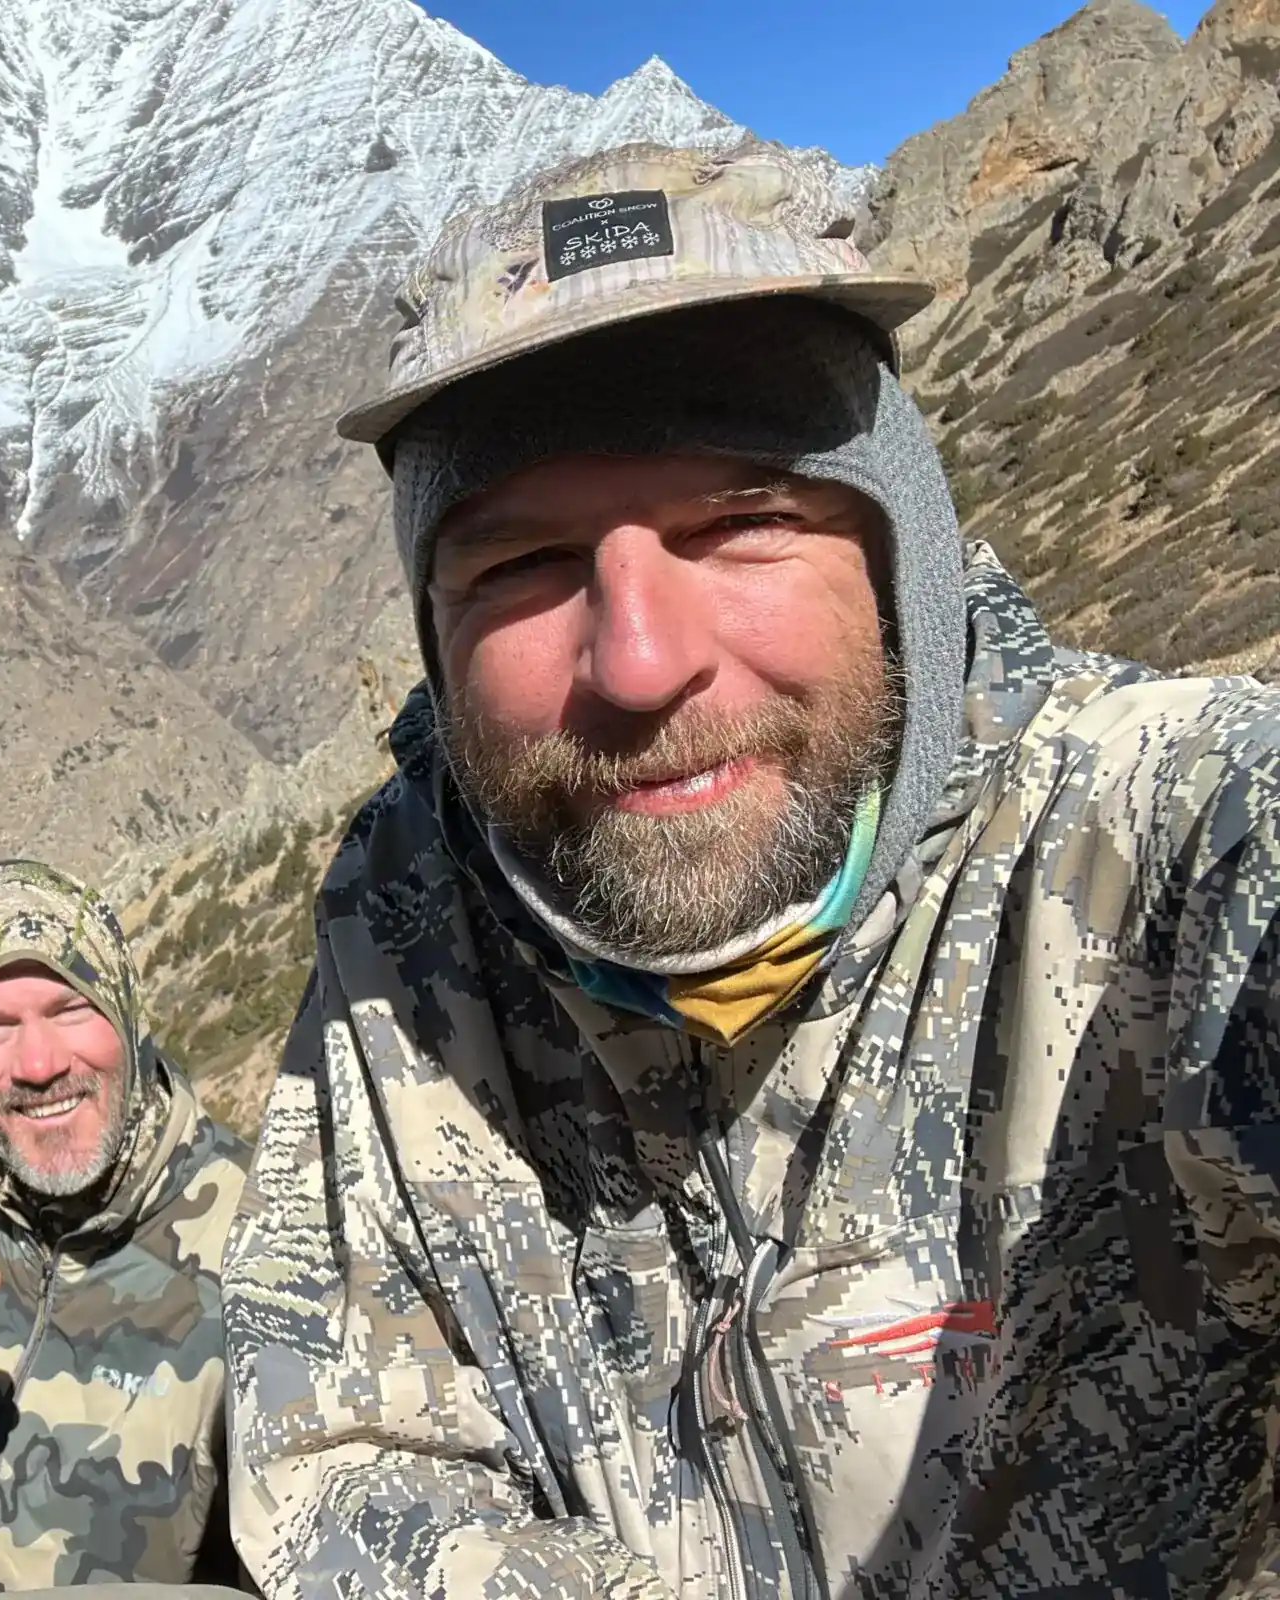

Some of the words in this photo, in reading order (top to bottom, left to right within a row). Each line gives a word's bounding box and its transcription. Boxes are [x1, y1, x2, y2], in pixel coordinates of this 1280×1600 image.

[552, 208, 615, 230] COALITION
[618, 203, 657, 213] SNOW
[563, 222, 650, 250] SKIDA
